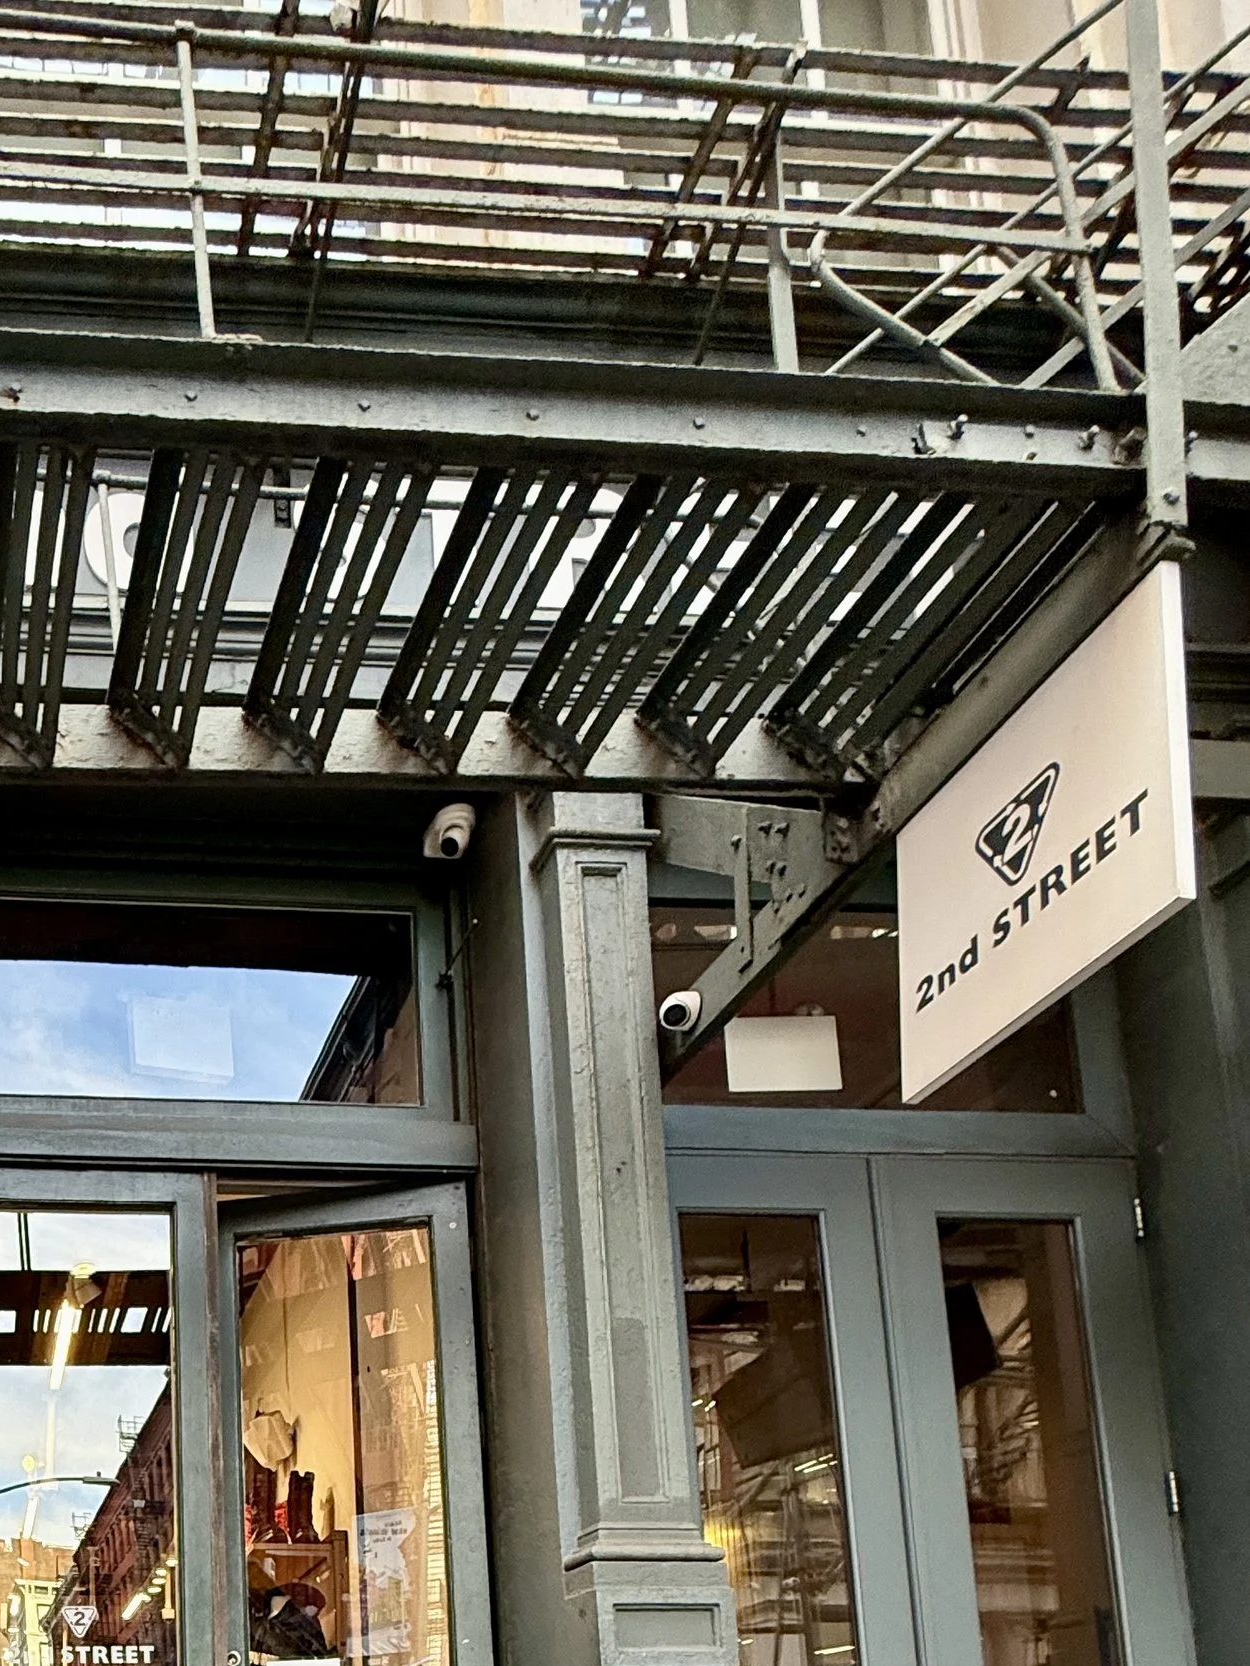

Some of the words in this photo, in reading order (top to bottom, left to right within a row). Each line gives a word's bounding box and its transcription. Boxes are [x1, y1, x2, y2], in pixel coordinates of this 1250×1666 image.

[916, 935, 979, 1014] 2nd
[993, 788, 1149, 949] STREET
[61, 1645, 155, 1664] STREET
